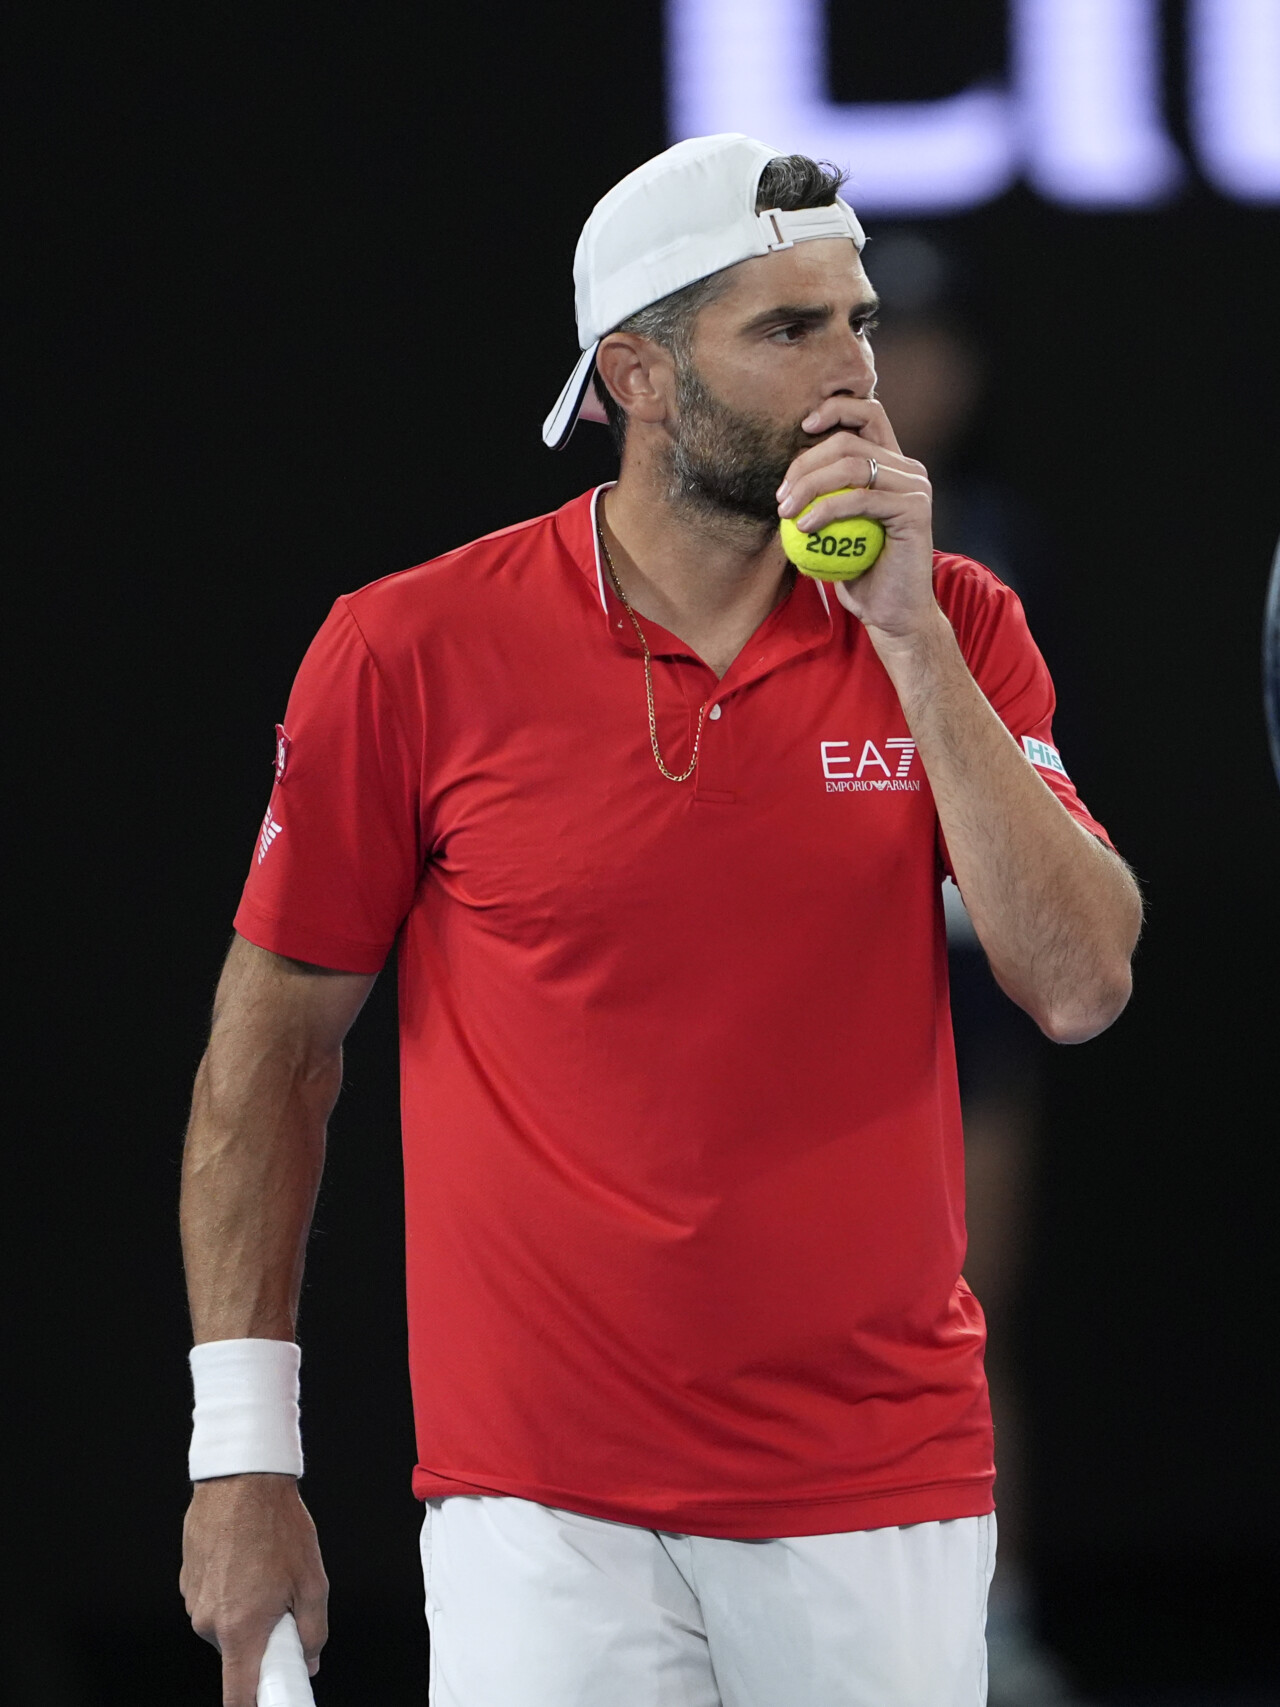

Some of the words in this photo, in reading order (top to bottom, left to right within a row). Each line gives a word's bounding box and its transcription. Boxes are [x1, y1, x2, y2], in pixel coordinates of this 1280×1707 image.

[806, 531, 867, 558] 2025
[820, 737, 916, 778] EA7
[825, 780, 873, 792] EMPORIO
[886, 779, 920, 791] ARMANI
